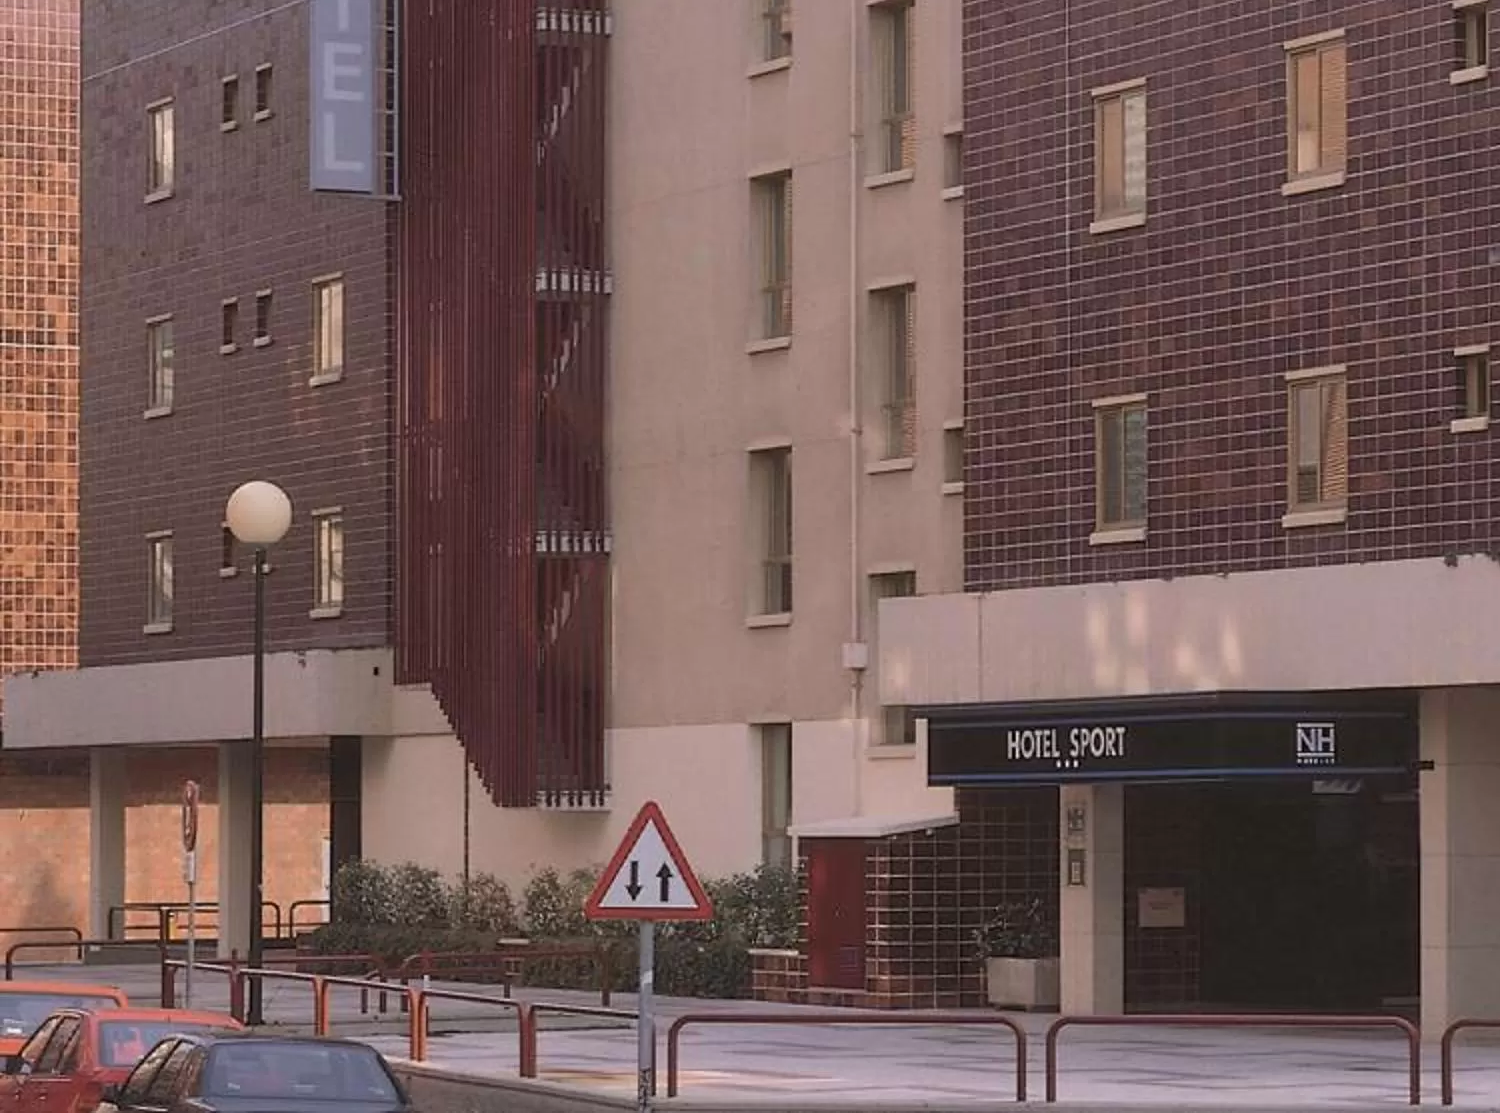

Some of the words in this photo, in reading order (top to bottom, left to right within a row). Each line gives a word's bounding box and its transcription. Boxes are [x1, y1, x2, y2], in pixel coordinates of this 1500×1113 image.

[1006, 728, 1060, 760] HOTEL
[1069, 726, 1126, 758] SPORT
[1296, 728, 1335, 752] NH
